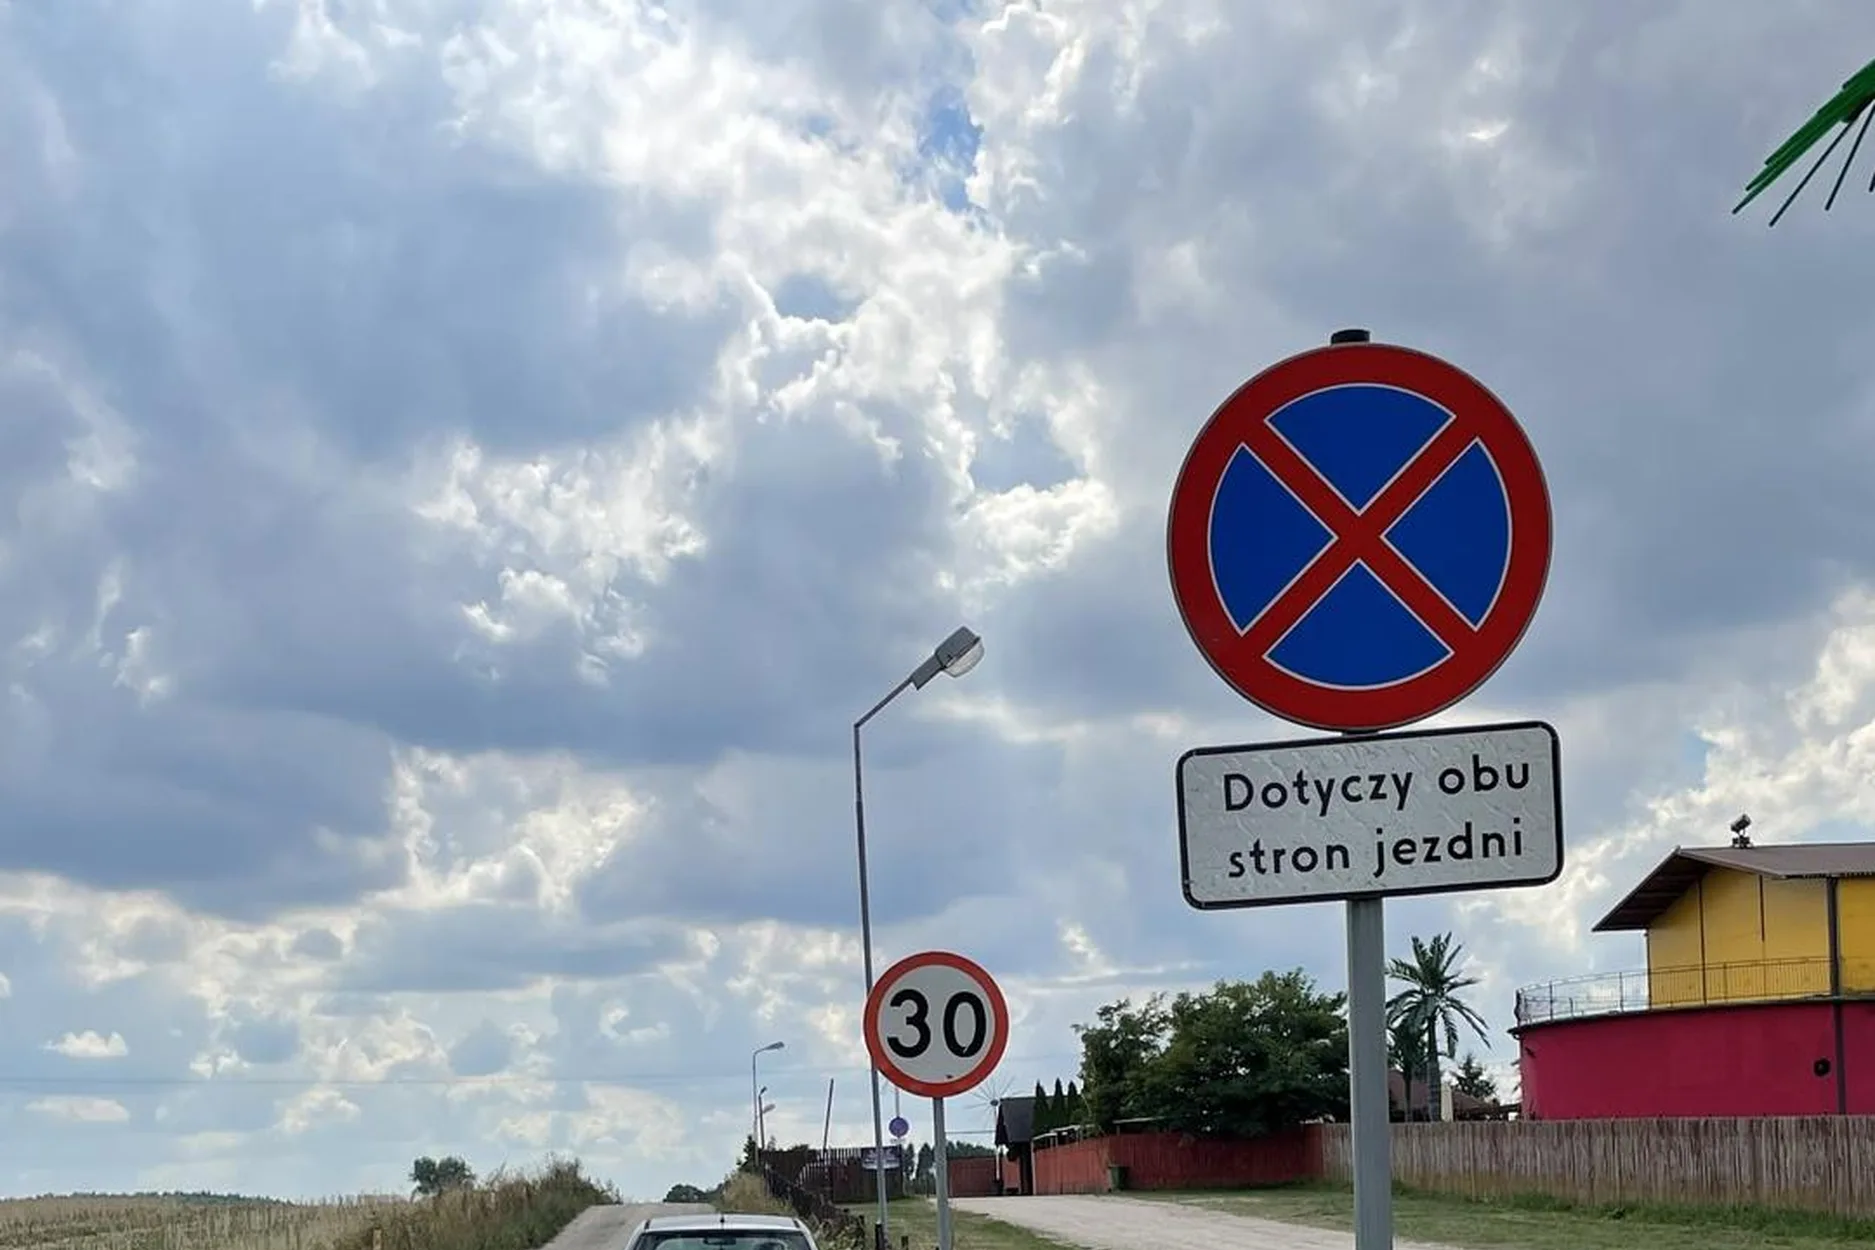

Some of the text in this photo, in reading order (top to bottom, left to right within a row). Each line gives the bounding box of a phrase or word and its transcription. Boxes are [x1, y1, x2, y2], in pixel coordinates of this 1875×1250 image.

[1223, 753, 1530, 817] Dotyczy obu
[1228, 817, 1523, 878] stron jezdni
[887, 988, 987, 1059] 30
